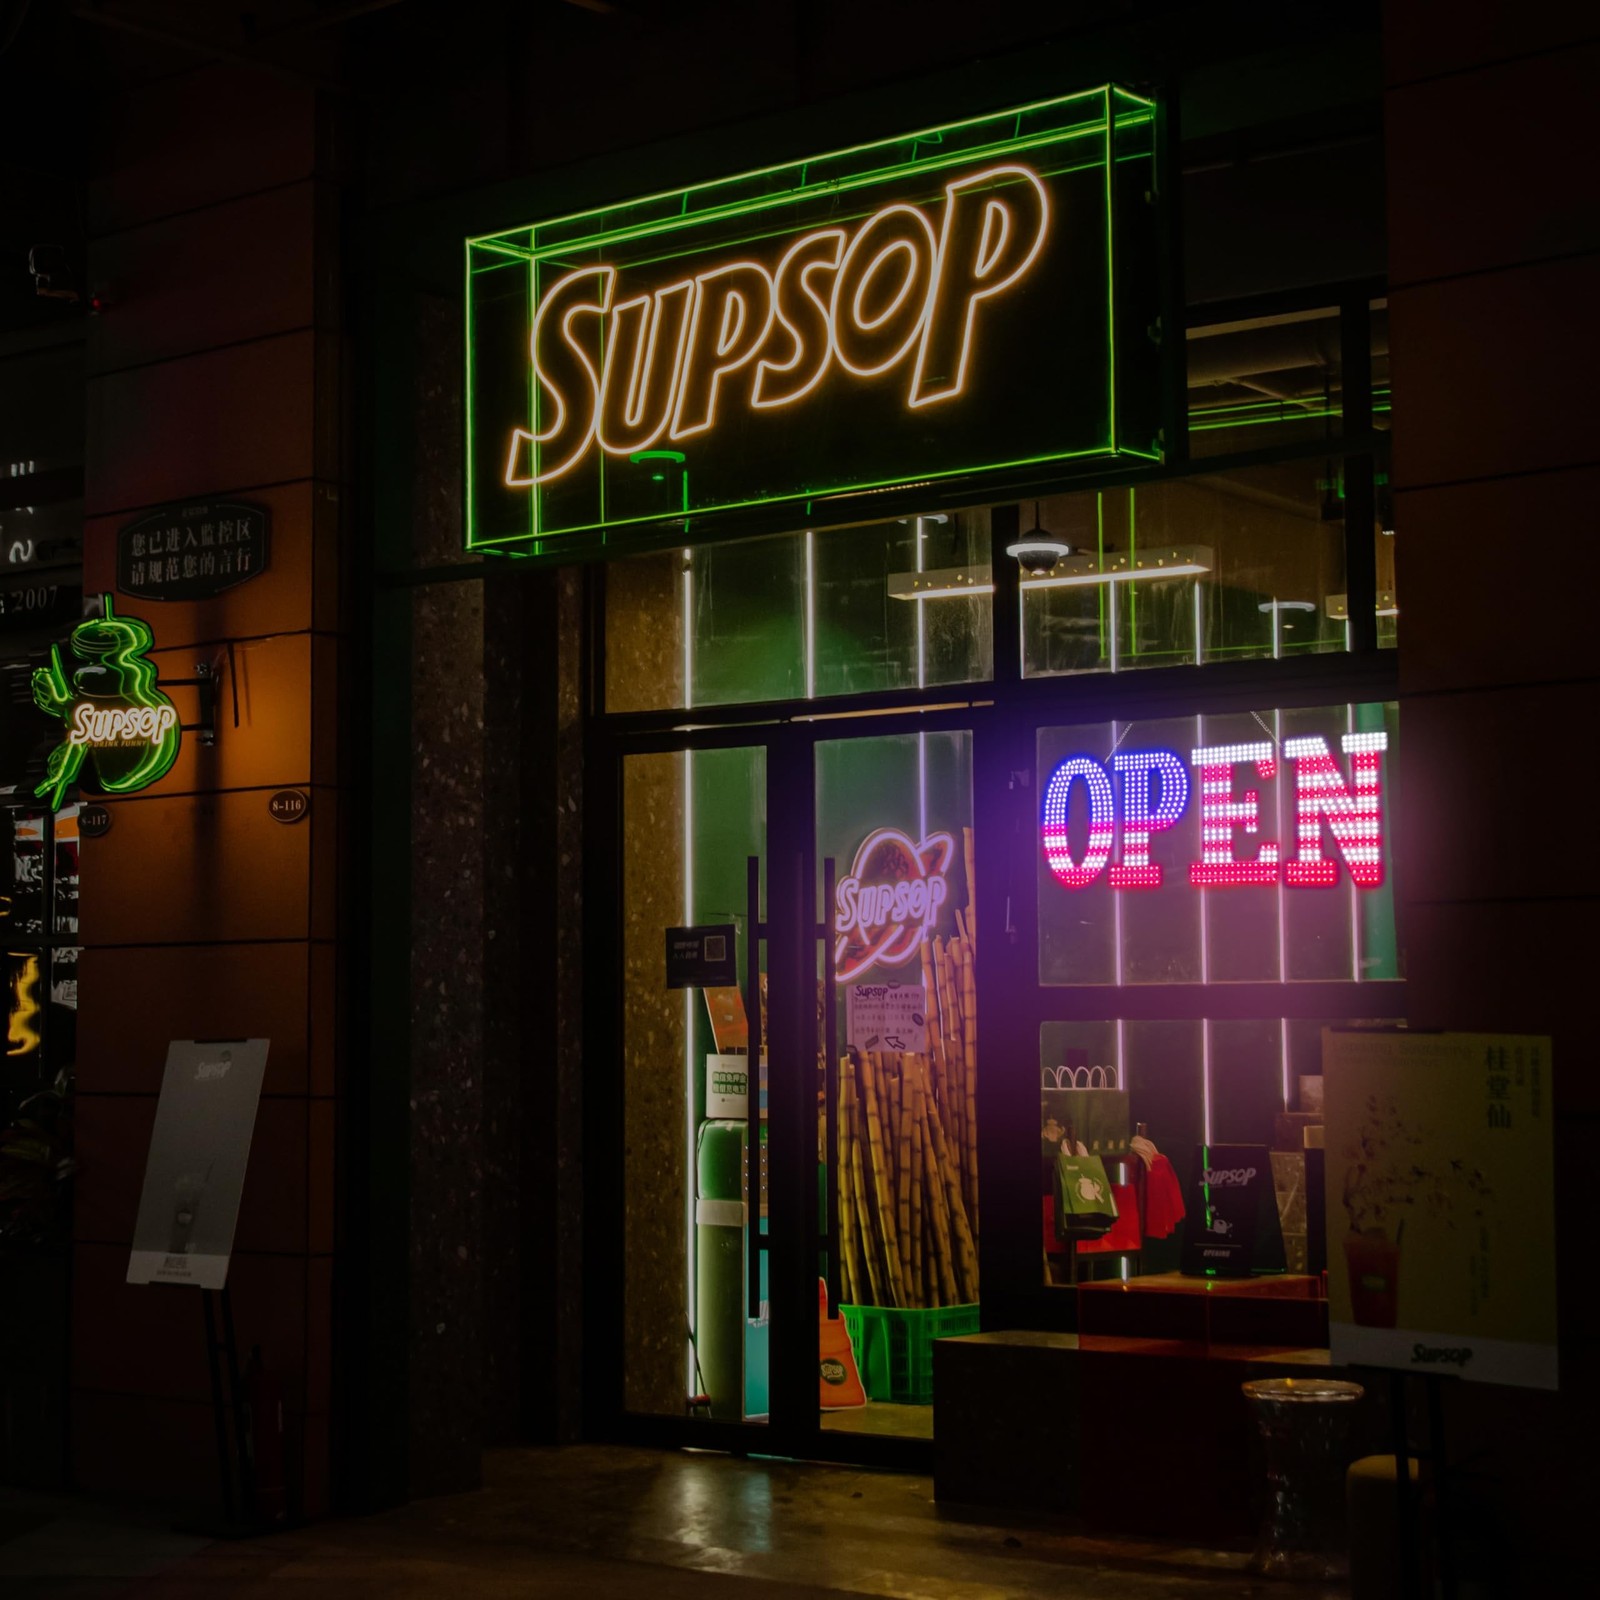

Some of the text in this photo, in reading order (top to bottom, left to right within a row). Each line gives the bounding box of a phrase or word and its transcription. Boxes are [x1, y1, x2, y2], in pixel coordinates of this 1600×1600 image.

[505, 165, 1048, 486] SUPSOP
[131, 516, 252, 557] 您已进入监控区
[130, 546, 252, 586] 请规范您的言行
[10, 585, 58, 613] 2007
[70, 702, 177, 744] SUPSOP
[272, 799, 301, 811] 8-116
[1042, 731, 1388, 889] OPEN
[834, 875, 948, 932] SUPSOP
[1198, 1167, 1257, 1186] SUPSOP
